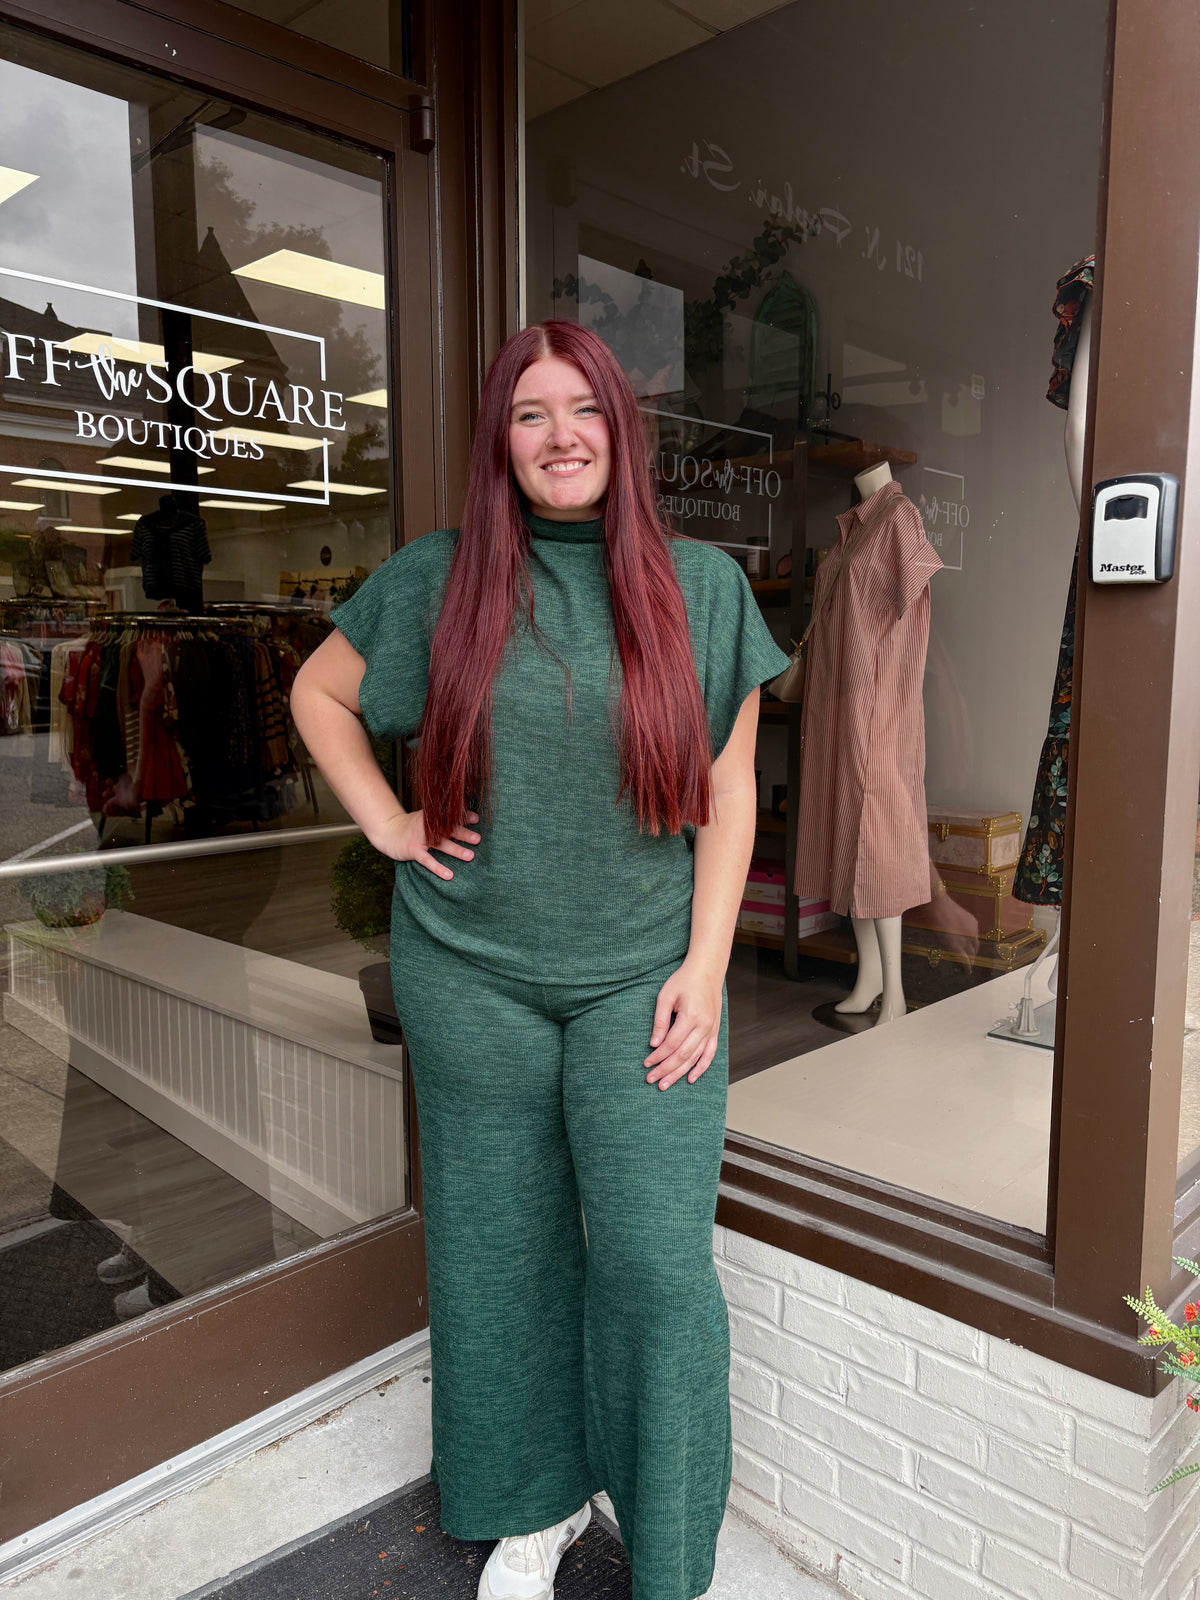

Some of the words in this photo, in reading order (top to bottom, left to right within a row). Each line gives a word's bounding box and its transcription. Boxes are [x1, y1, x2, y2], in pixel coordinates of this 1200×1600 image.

[1, 331, 72, 387] FF
[75, 343, 143, 401] the
[145, 359, 347, 431] SQUARE
[74, 410, 265, 460] BOUTIQUES
[1099, 563, 1145, 572] Master
